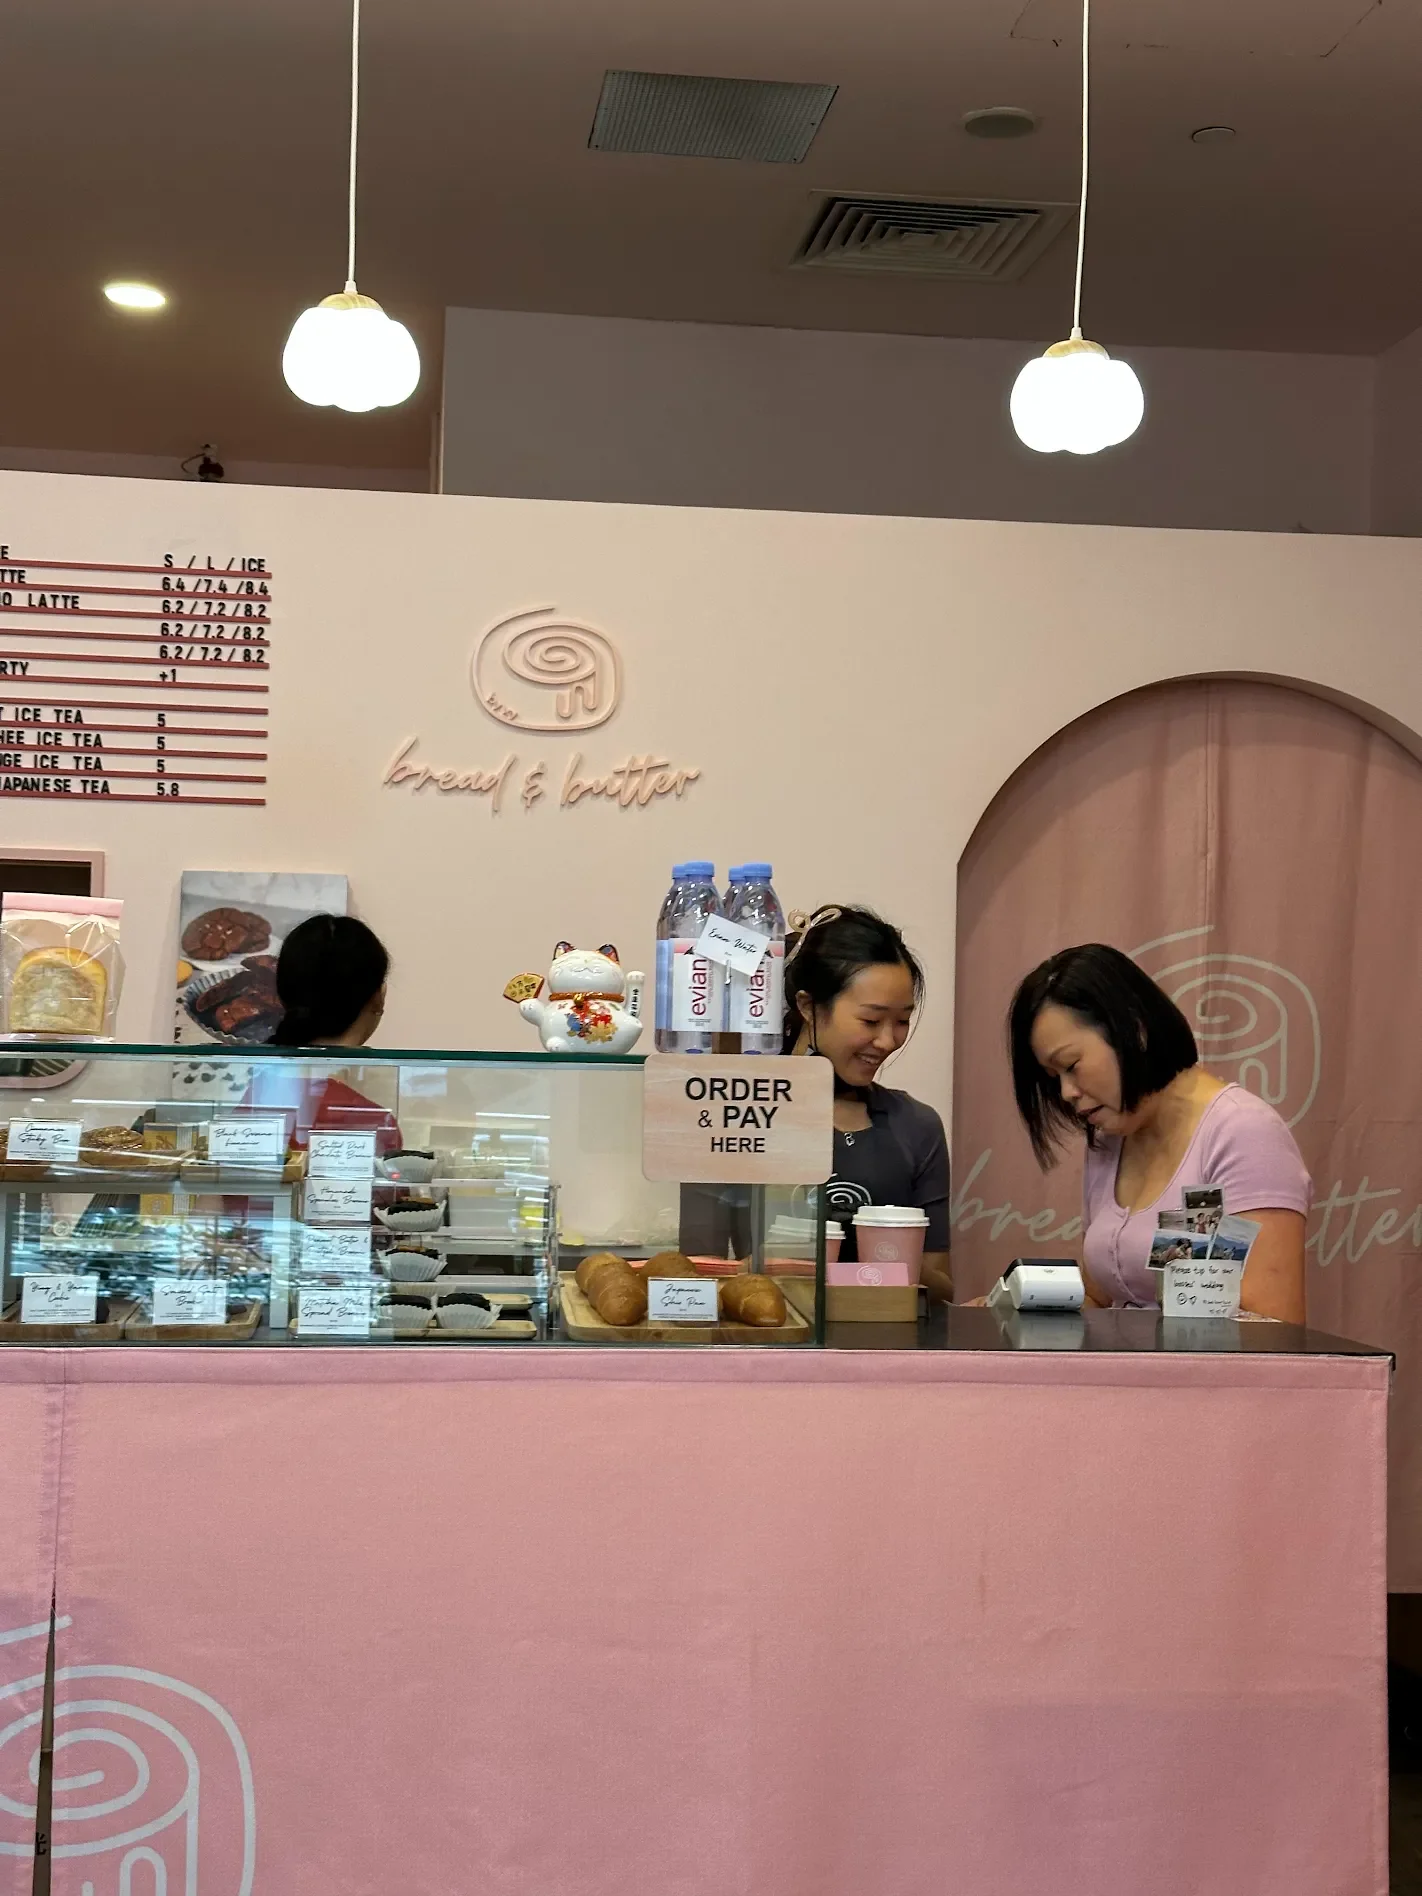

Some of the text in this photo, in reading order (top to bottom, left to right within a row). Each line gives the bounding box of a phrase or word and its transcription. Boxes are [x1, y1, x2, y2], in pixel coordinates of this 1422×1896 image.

[164, 554, 173, 568] S
[207, 556, 215, 570] L
[242, 557, 266, 572] ICE
[28, 593, 80, 610] LATTE
[159, 669, 177, 682] +1
[15, 708, 41, 722] ICE
[54, 709, 84, 724] TEA
[157, 713, 166, 727] 5
[37, 732, 62, 746] ICE
[73, 733, 103, 748] TEA
[157, 736, 165, 750] 5
[34, 754, 59, 769] ICE
[74, 756, 103, 771] TEA
[157, 759, 165, 773] 5
[383, 736, 700, 814] bread & butter
[0, 777, 180, 797] APANESE TEA 5.8
[689, 959, 708, 1016] evian
[685, 1077, 792, 1102] ORDER
[698, 1105, 779, 1128] & PAY
[710, 1137, 766, 1153] HERE
